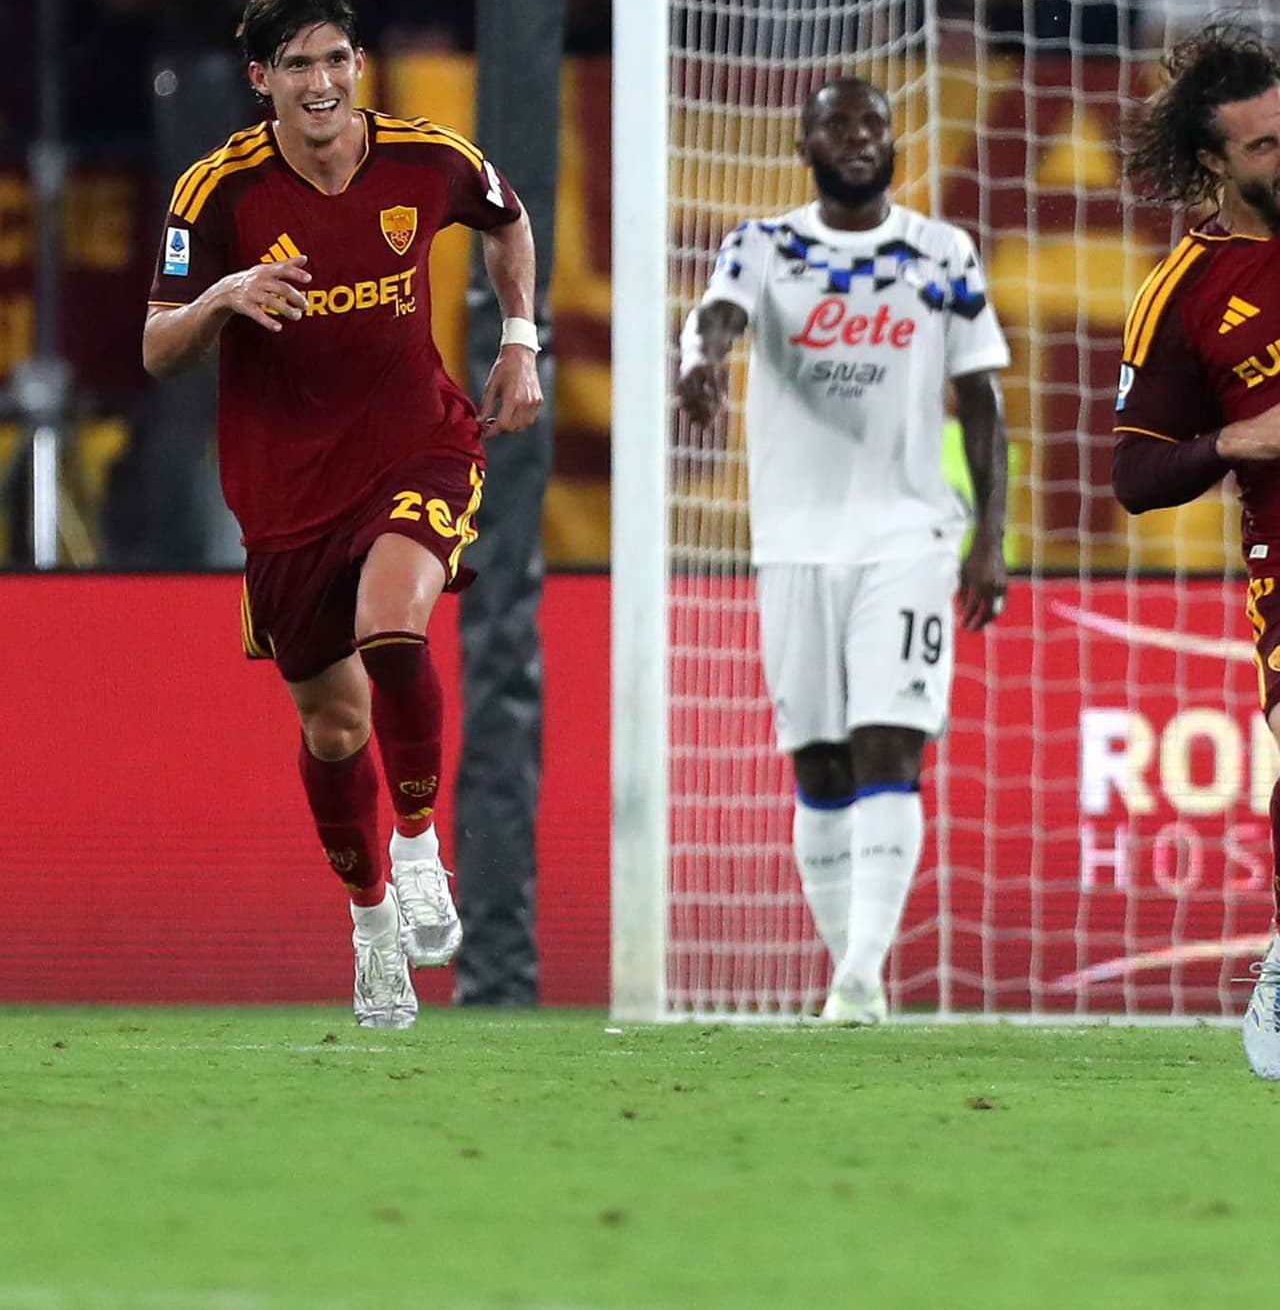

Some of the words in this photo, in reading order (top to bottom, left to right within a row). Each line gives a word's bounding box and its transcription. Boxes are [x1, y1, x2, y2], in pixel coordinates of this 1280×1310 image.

[260, 266, 418, 317] ROBET
[788, 295, 917, 350] Lete
[899, 608, 943, 664] 19
